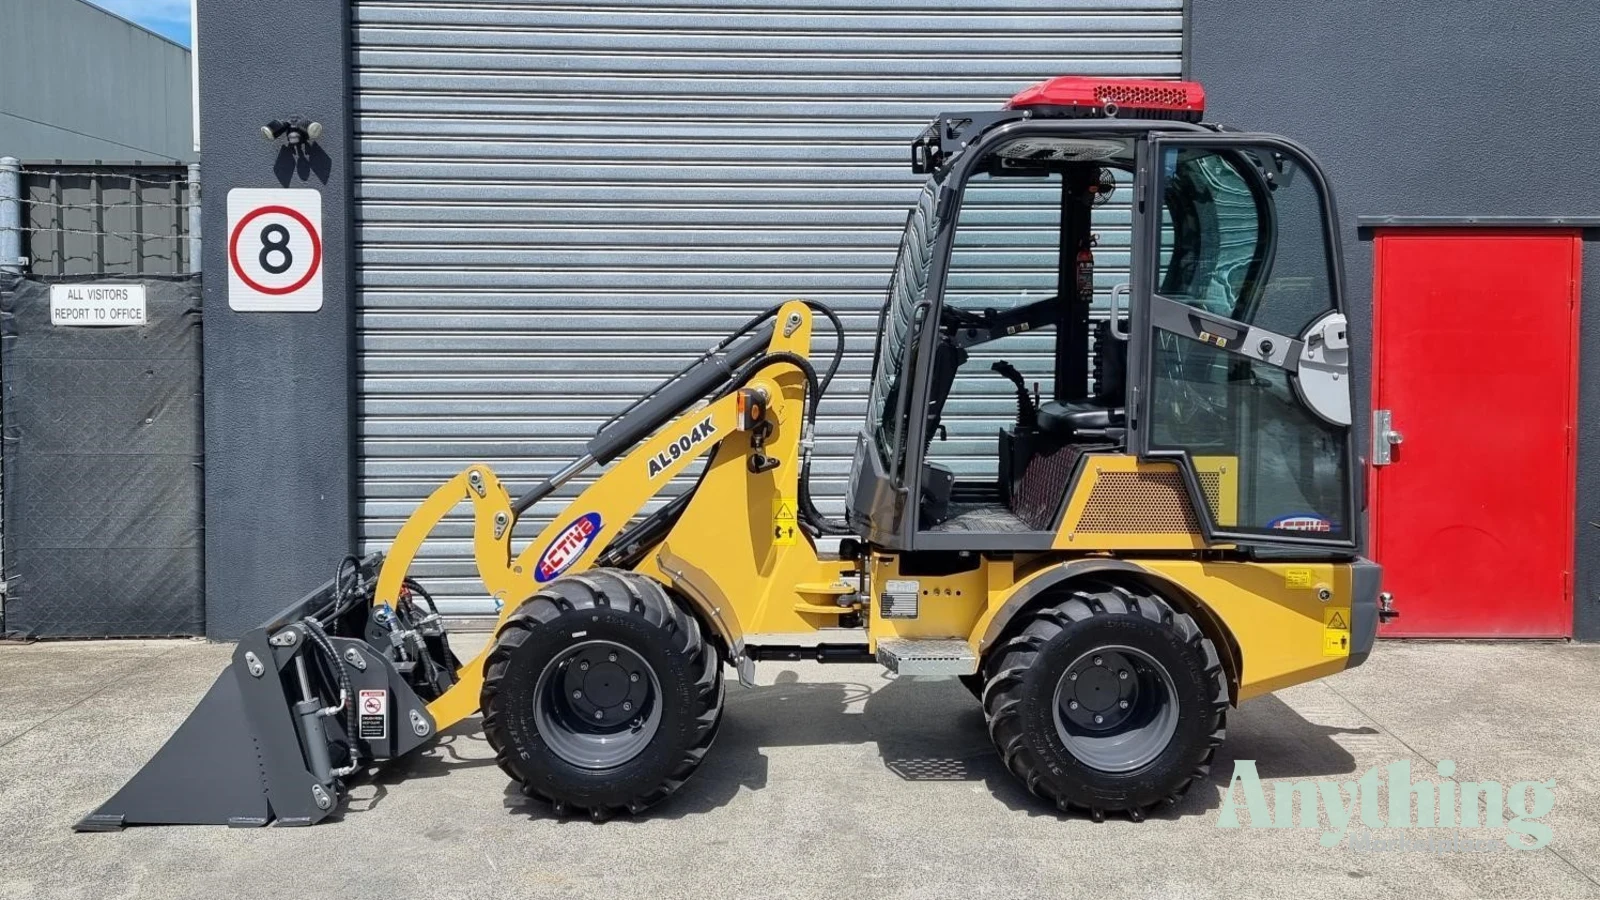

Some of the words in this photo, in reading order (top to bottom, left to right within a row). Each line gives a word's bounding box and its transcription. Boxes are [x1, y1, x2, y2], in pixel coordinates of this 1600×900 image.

[259, 223, 293, 274] 8
[67, 289, 83, 300] ALL
[87, 289, 128, 300] VISITORS
[54, 308, 90, 319] REPORT
[94, 308, 106, 319] TO
[110, 308, 142, 319] OFFICE
[648, 415, 717, 479] AL904K
